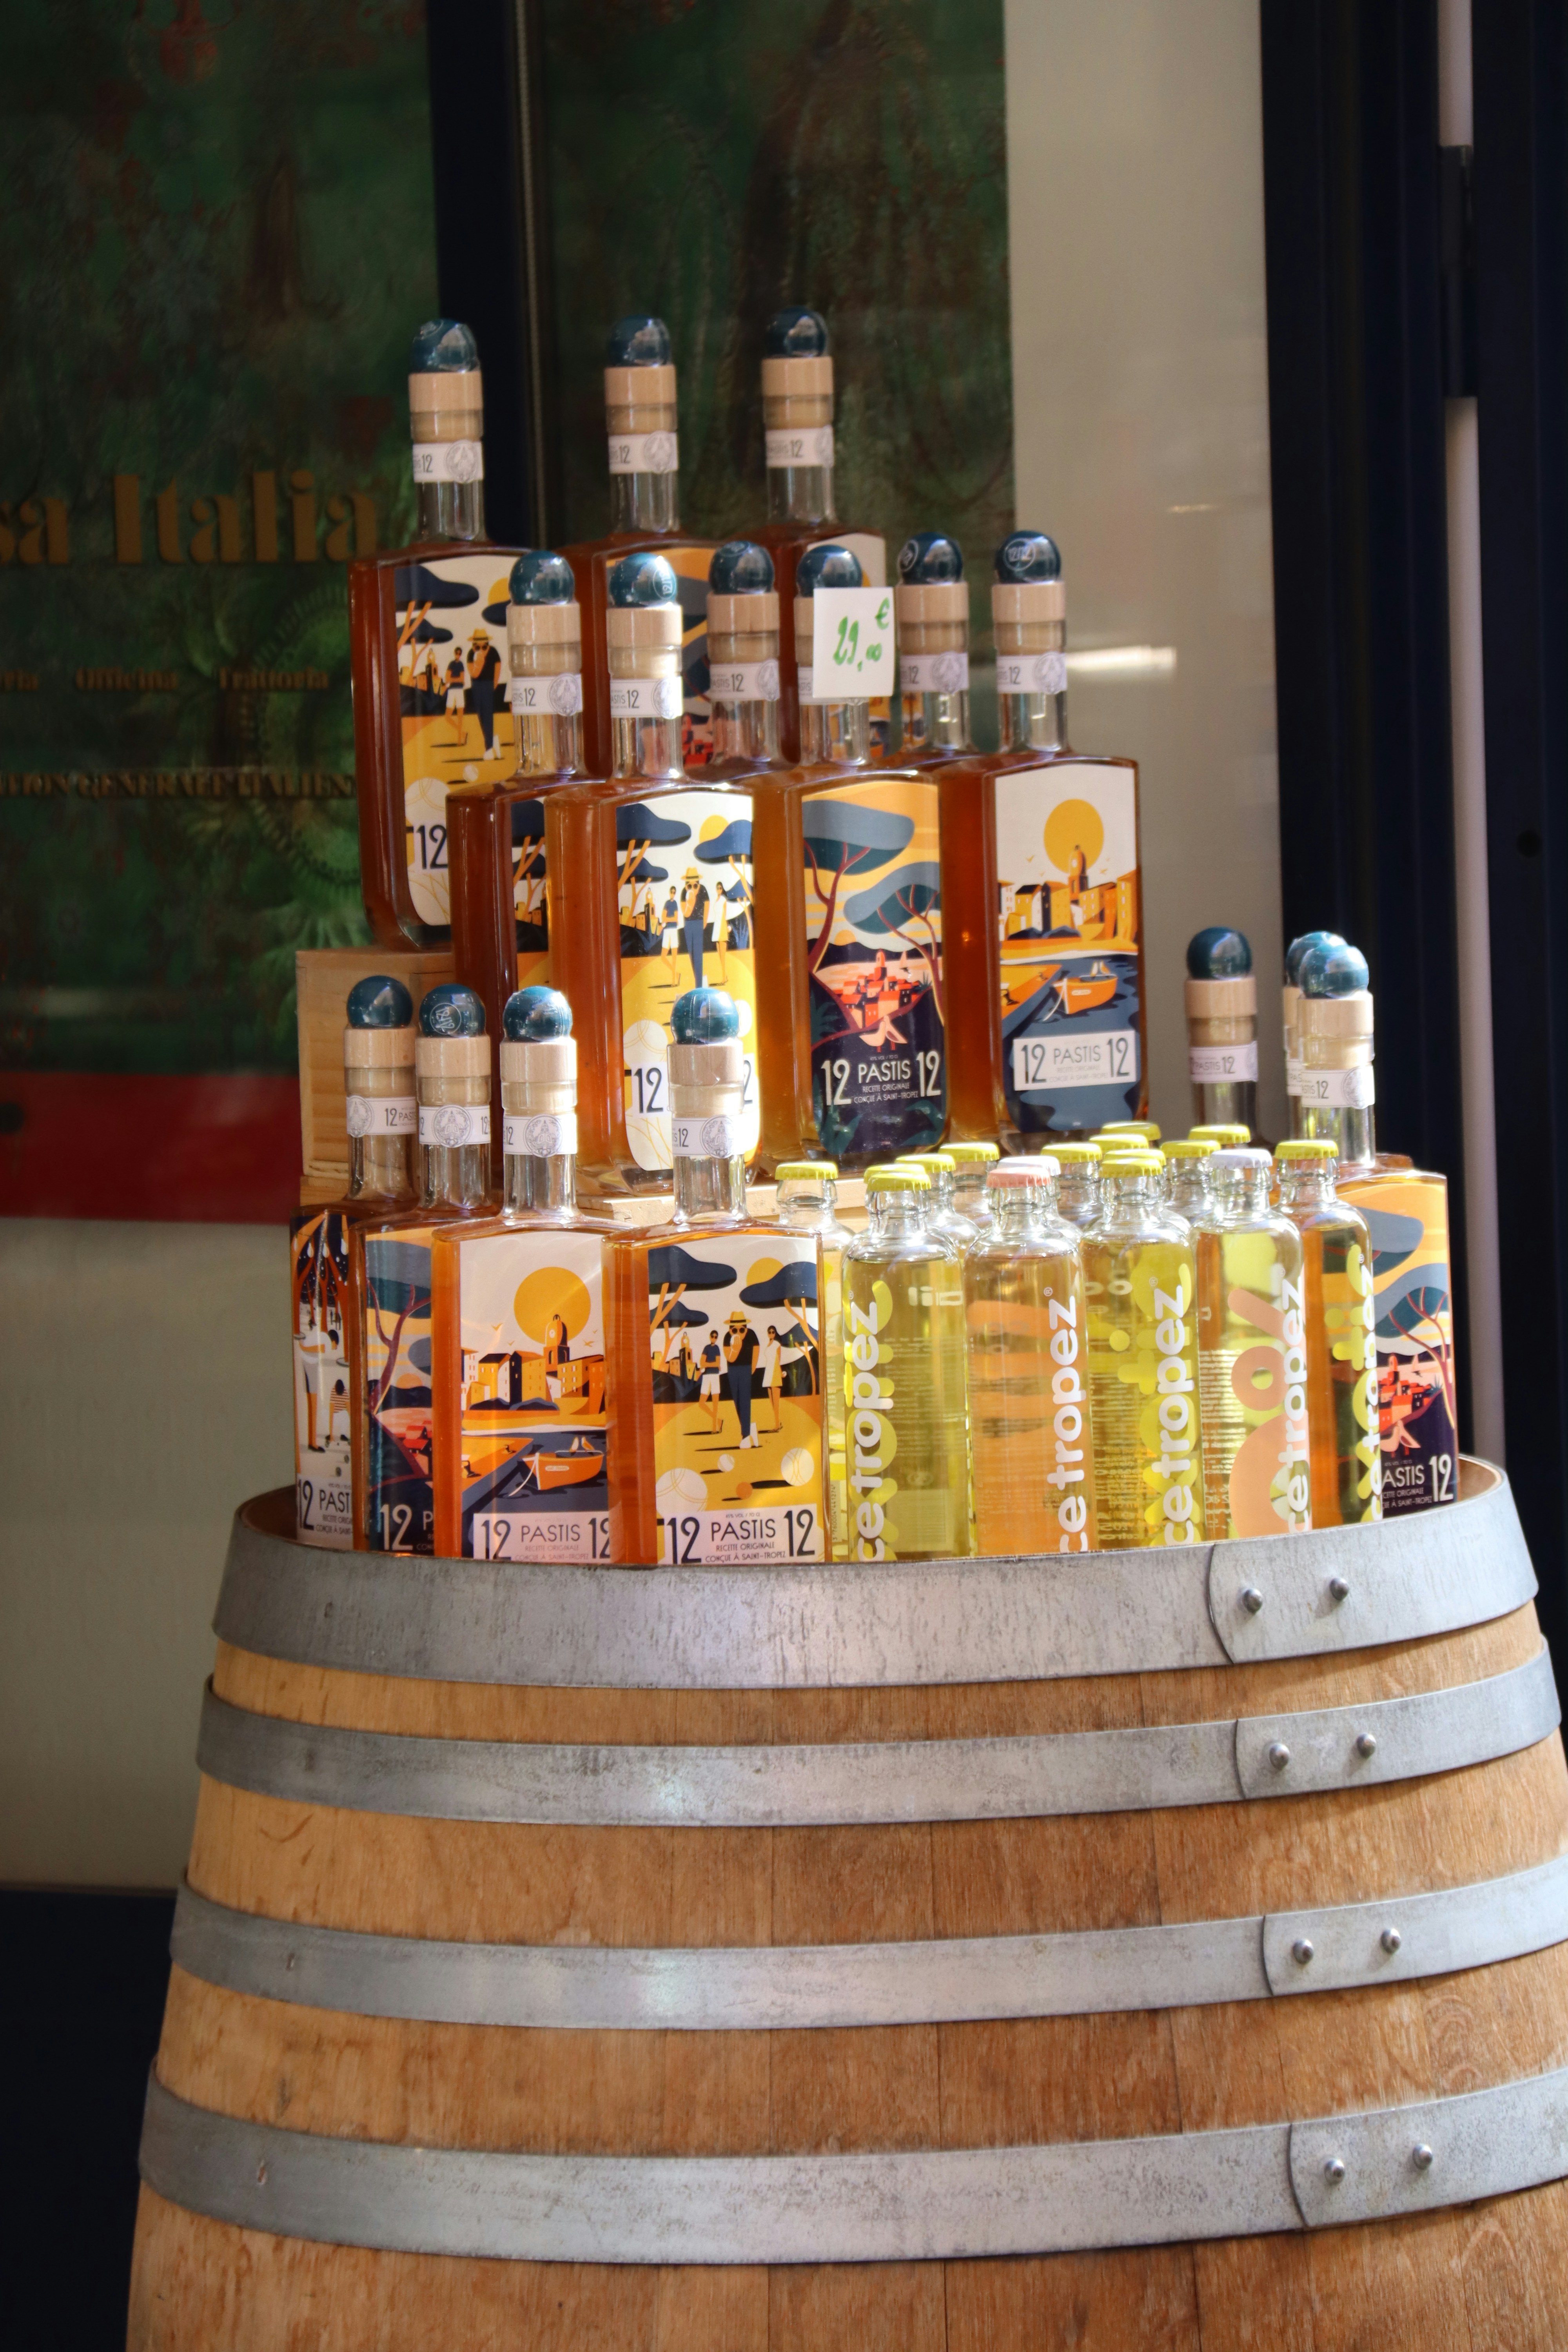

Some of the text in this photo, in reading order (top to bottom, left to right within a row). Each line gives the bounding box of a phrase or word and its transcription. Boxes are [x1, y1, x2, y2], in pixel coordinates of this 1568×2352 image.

[619, 445, 630, 464] 12
[790, 439, 804, 458] 12
[422, 453, 433, 473] 12
[113, 470, 376, 564] Italia
[731, 673, 744, 692] 12
[908, 666, 920, 684] 12
[1009, 666, 1021, 684] 12
[524, 688, 536, 706] 12
[627, 690, 640, 708] 12
[416, 824, 448, 869] 12
[1021, 1038, 1130, 1084] 12 PASTIS 12
[1222, 1056, 1236, 1074] 12
[821, 1051, 941, 1105] 12 PASTIS 12
[882, 1083, 910, 1091] ORIGINALE
[634, 1067, 663, 1114] 12
[1316, 1080, 1329, 1099] 12
[385, 1108, 397, 1127] 12
[481, 1116, 488, 1135] 12
[506, 1126, 514, 1145] 12
[678, 1128, 689, 1147] 12
[1382, 1454, 1454, 1502] ASTIS 12
[298, 1479, 350, 1531] 12 PAST
[379, 1504, 413, 1550] 12
[666, 1509, 815, 1564] 12 PASTIS 12
[481, 1520, 511, 1560] 12
[521, 1524, 580, 1543] PASTIS
[716, 1542, 775, 1552] RECETTE ORIGINALE
[705, 1551, 786, 1563] CONÇUE À SAINT-TROPEZ
